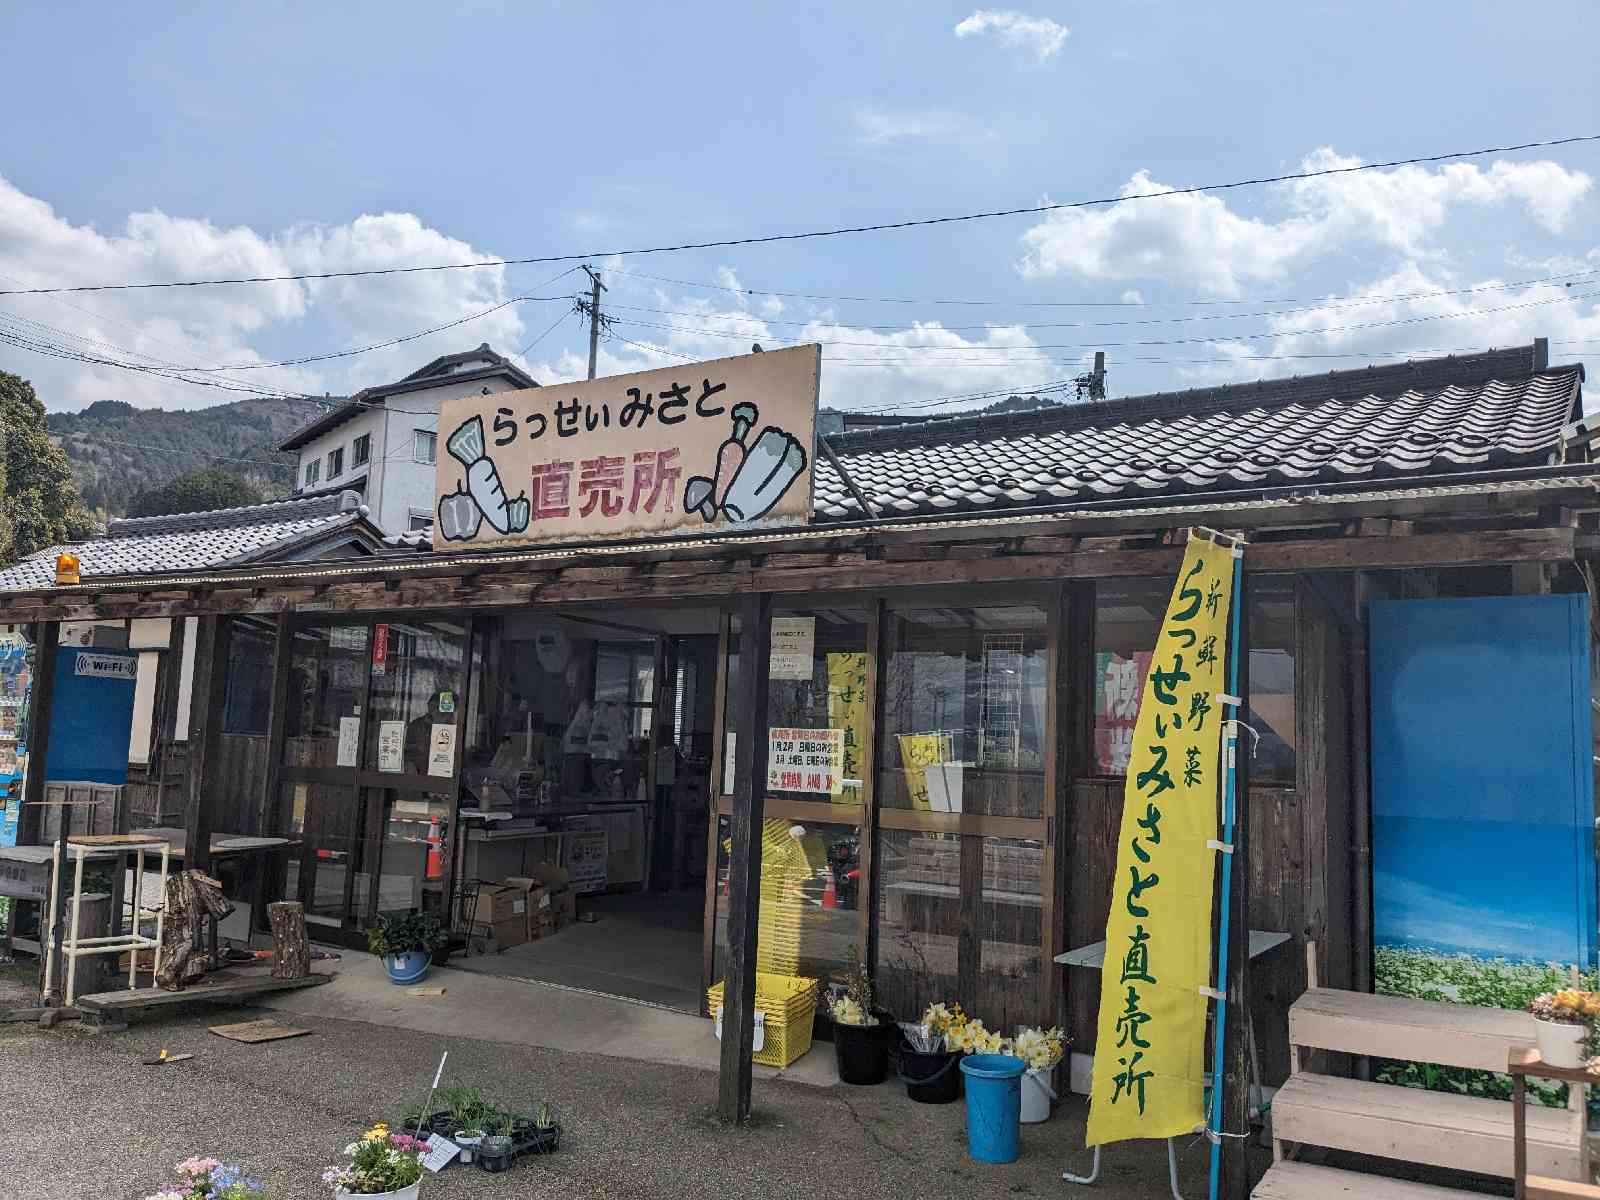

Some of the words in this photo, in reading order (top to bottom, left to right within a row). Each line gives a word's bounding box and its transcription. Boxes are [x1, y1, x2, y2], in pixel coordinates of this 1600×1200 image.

[492, 378, 727, 446] らっせいみさと
[530, 447, 683, 522] 直売所
[93, 661, 122, 672] Wi-Fi
[1183, 577, 1224, 787] 新鮮野菜
[1110, 558, 1204, 1116] らっせいみさと直売所
